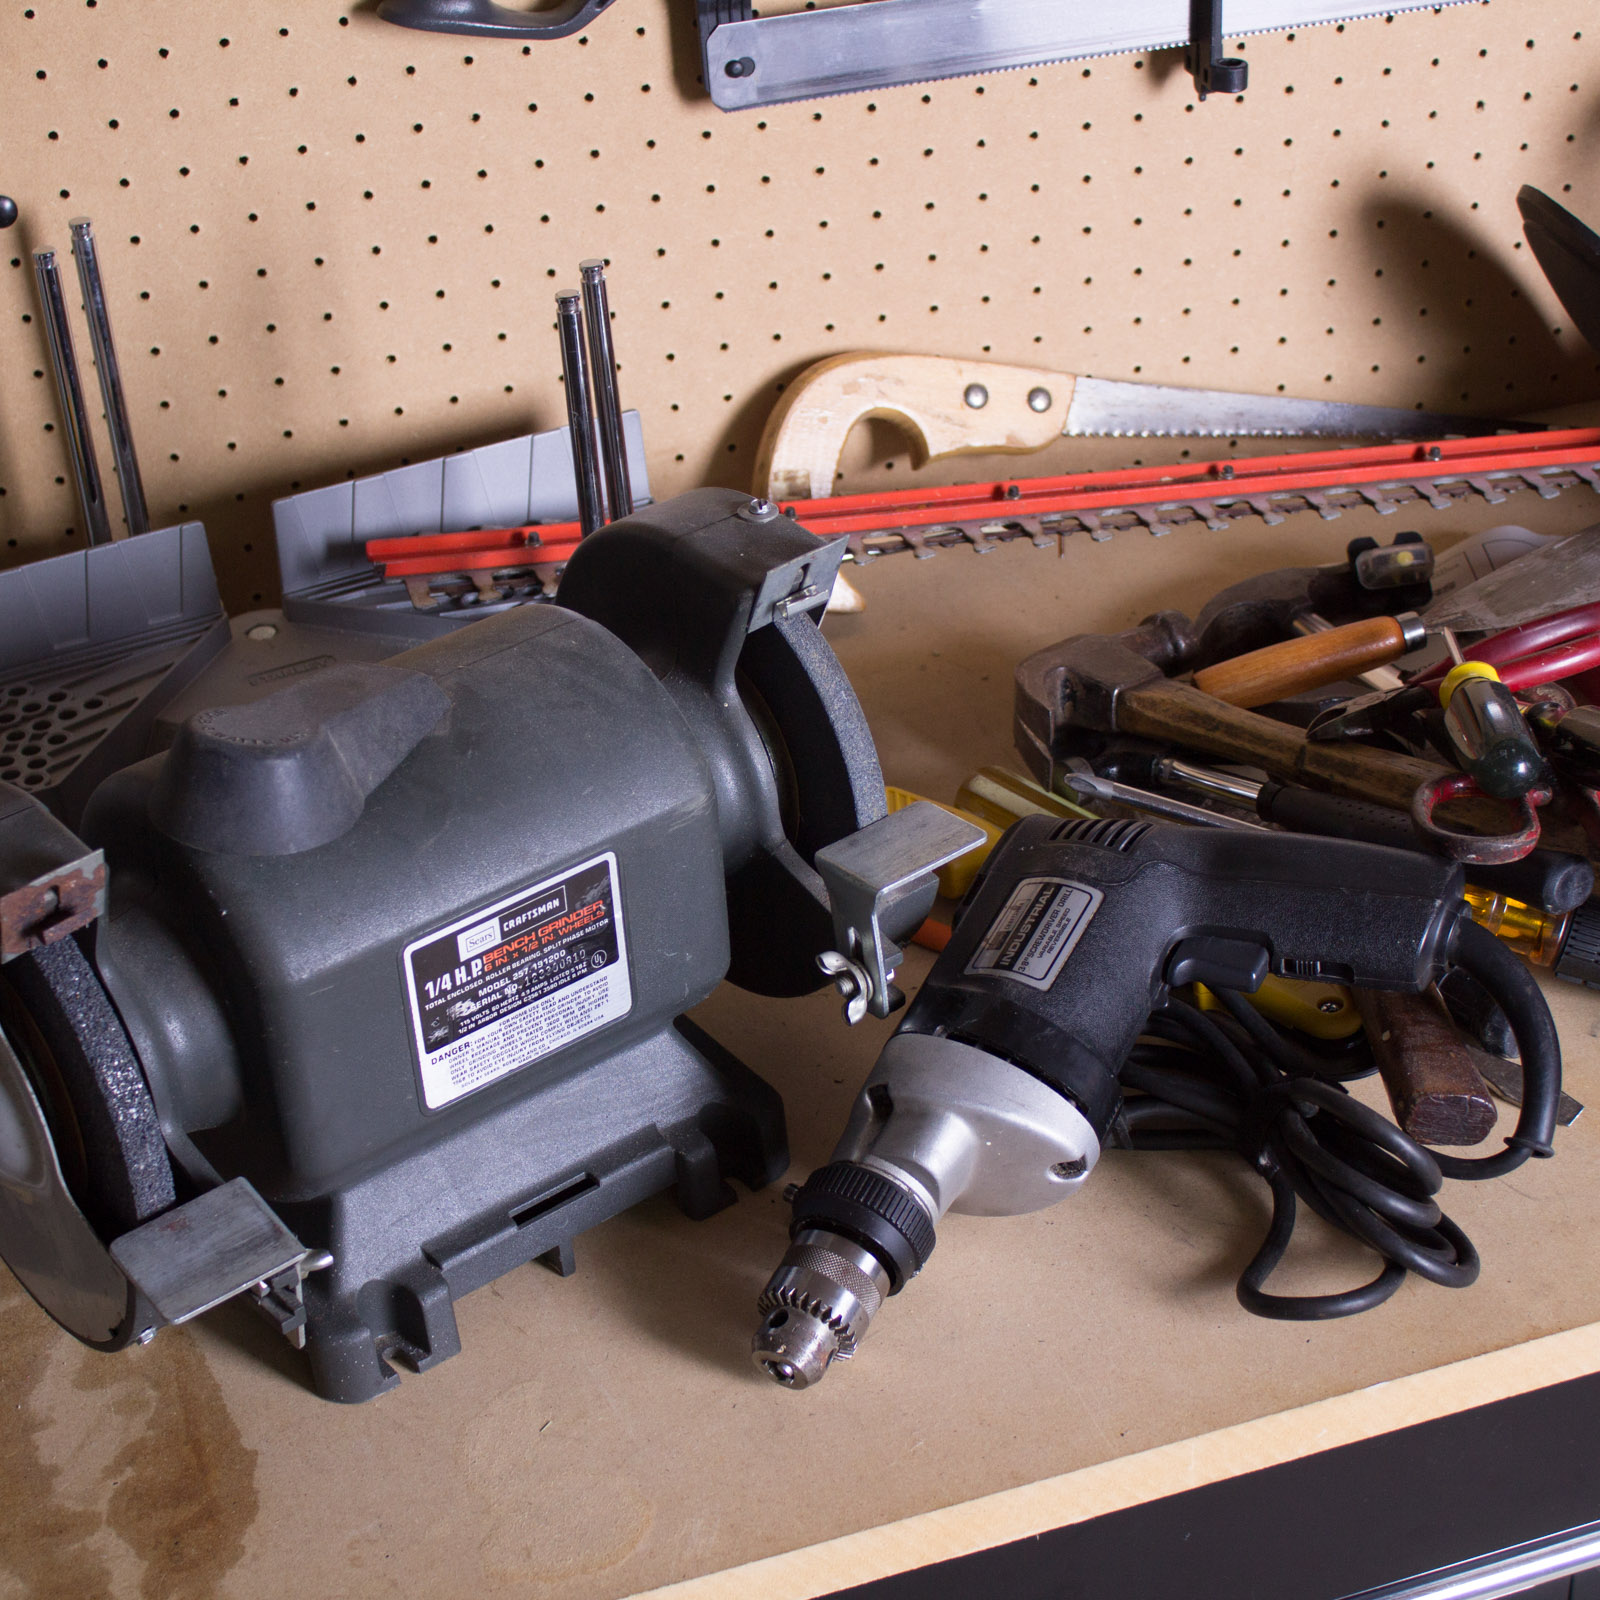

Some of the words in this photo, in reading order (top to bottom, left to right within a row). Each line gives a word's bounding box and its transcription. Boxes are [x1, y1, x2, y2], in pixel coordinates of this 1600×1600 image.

[468, 930, 492, 949] Sears
[483, 931, 536, 964] BENCH
[538, 899, 604, 938] GRINDER
[503, 898, 560, 932] CRAFTSMAN
[999, 886, 1055, 965] INDUSTRIAL
[1037, 930, 1058, 959] VARIABLE
[1055, 908, 1071, 928] SPEED
[1047, 918, 1072, 954] REVERSIBLE
[425, 996, 446, 1011] TOTAL
[486, 965, 511, 982] ROLLER
[544, 940, 562, 954] SPLIT
[563, 930, 584, 945] PHASE
[585, 918, 609, 934] MOTOR
[485, 962, 493, 973] 6
[495, 954, 509, 968] IN.
[522, 940, 539, 955] 1/2
[542, 932, 556, 945] IN.
[559, 909, 605, 937] WHEELS
[595, 952, 603, 966] UL
[424, 972, 452, 1001] 1/4
[455, 957, 483, 987] H.P.
[460, 1019, 470, 1027] 115
[471, 1009, 490, 1022] VOLTS
[492, 1004, 499, 1012] 60
[500, 995, 519, 1008] HERTZ
[531, 981, 548, 993] AMPS
[550, 970, 570, 984] LISTED
[478, 976, 511, 998] MODEL
[513, 949, 566, 981] 257.191200
[431, 1040, 473, 1066] DANGER:
[475, 1036, 485, 1045] FOR
[488, 1028, 502, 1038] YOUR
[504, 1020, 517, 1030] OWN
[542, 1001, 556, 1012] READ
[558, 995, 570, 1004] AND
[571, 976, 608, 998] UNDERSTAND
[459, 1026, 467, 1034] 1/2
[477, 1011, 498, 1025] ARBOR
[500, 1000, 522, 1014] DESIGN
[559, 976, 571, 986] IDLE
[471, 990, 502, 1012] SERIAL
[477, 1035, 500, 1050] MANUAL
[502, 1024, 523, 1038] BEFORE
[525, 1007, 556, 1026] OPERATING
[593, 982, 608, 993] AVOID
[499, 1018, 510, 1027] FOR
[511, 1010, 527, 1022] HOME
[529, 1004, 539, 1013] USE
[541, 997, 555, 1007] ONLY
[450, 1057, 469, 1070] WHEEL
[472, 1041, 500, 1059] BREAKAGE
[503, 1034, 515, 1043] AND
[517, 1021, 542, 1036] PREVENT
[545, 1005, 573, 1023] PERSONAL
[599, 988, 609, 996] USE
[451, 1064, 465, 1075] ONLY
[469, 1049, 497, 1066] GRINDING
[500, 1036, 522, 1051] WHEELS
[526, 1026, 543, 1038] RATED
[563, 1010, 575, 1020] RPM
[589, 993, 609, 1007] HIGHER
[451, 1069, 467, 1081] WEAR
[470, 1058, 490, 1072] SAFETY
[492, 1044, 518, 1061] GOGGLES
[520, 1034, 538, 1047] WHICH
[541, 1022, 563, 1037] COMPLY
[565, 1014, 578, 1025] WITH
[580, 1007, 593, 1017] ANSI
[477, 1063, 493, 1074] AVOID
[495, 1057, 504, 1065] EYE
[507, 1046, 527, 1059] INJURY
[529, 1037, 544, 1048] FROM
[546, 1027, 565, 1040] FLYING
[462, 1079, 475, 1088] SOLD
[503, 1054, 525, 1068] ROEBUCK
[527, 1048, 537, 1056] AND
[518, 1055, 532, 1064] MADE
